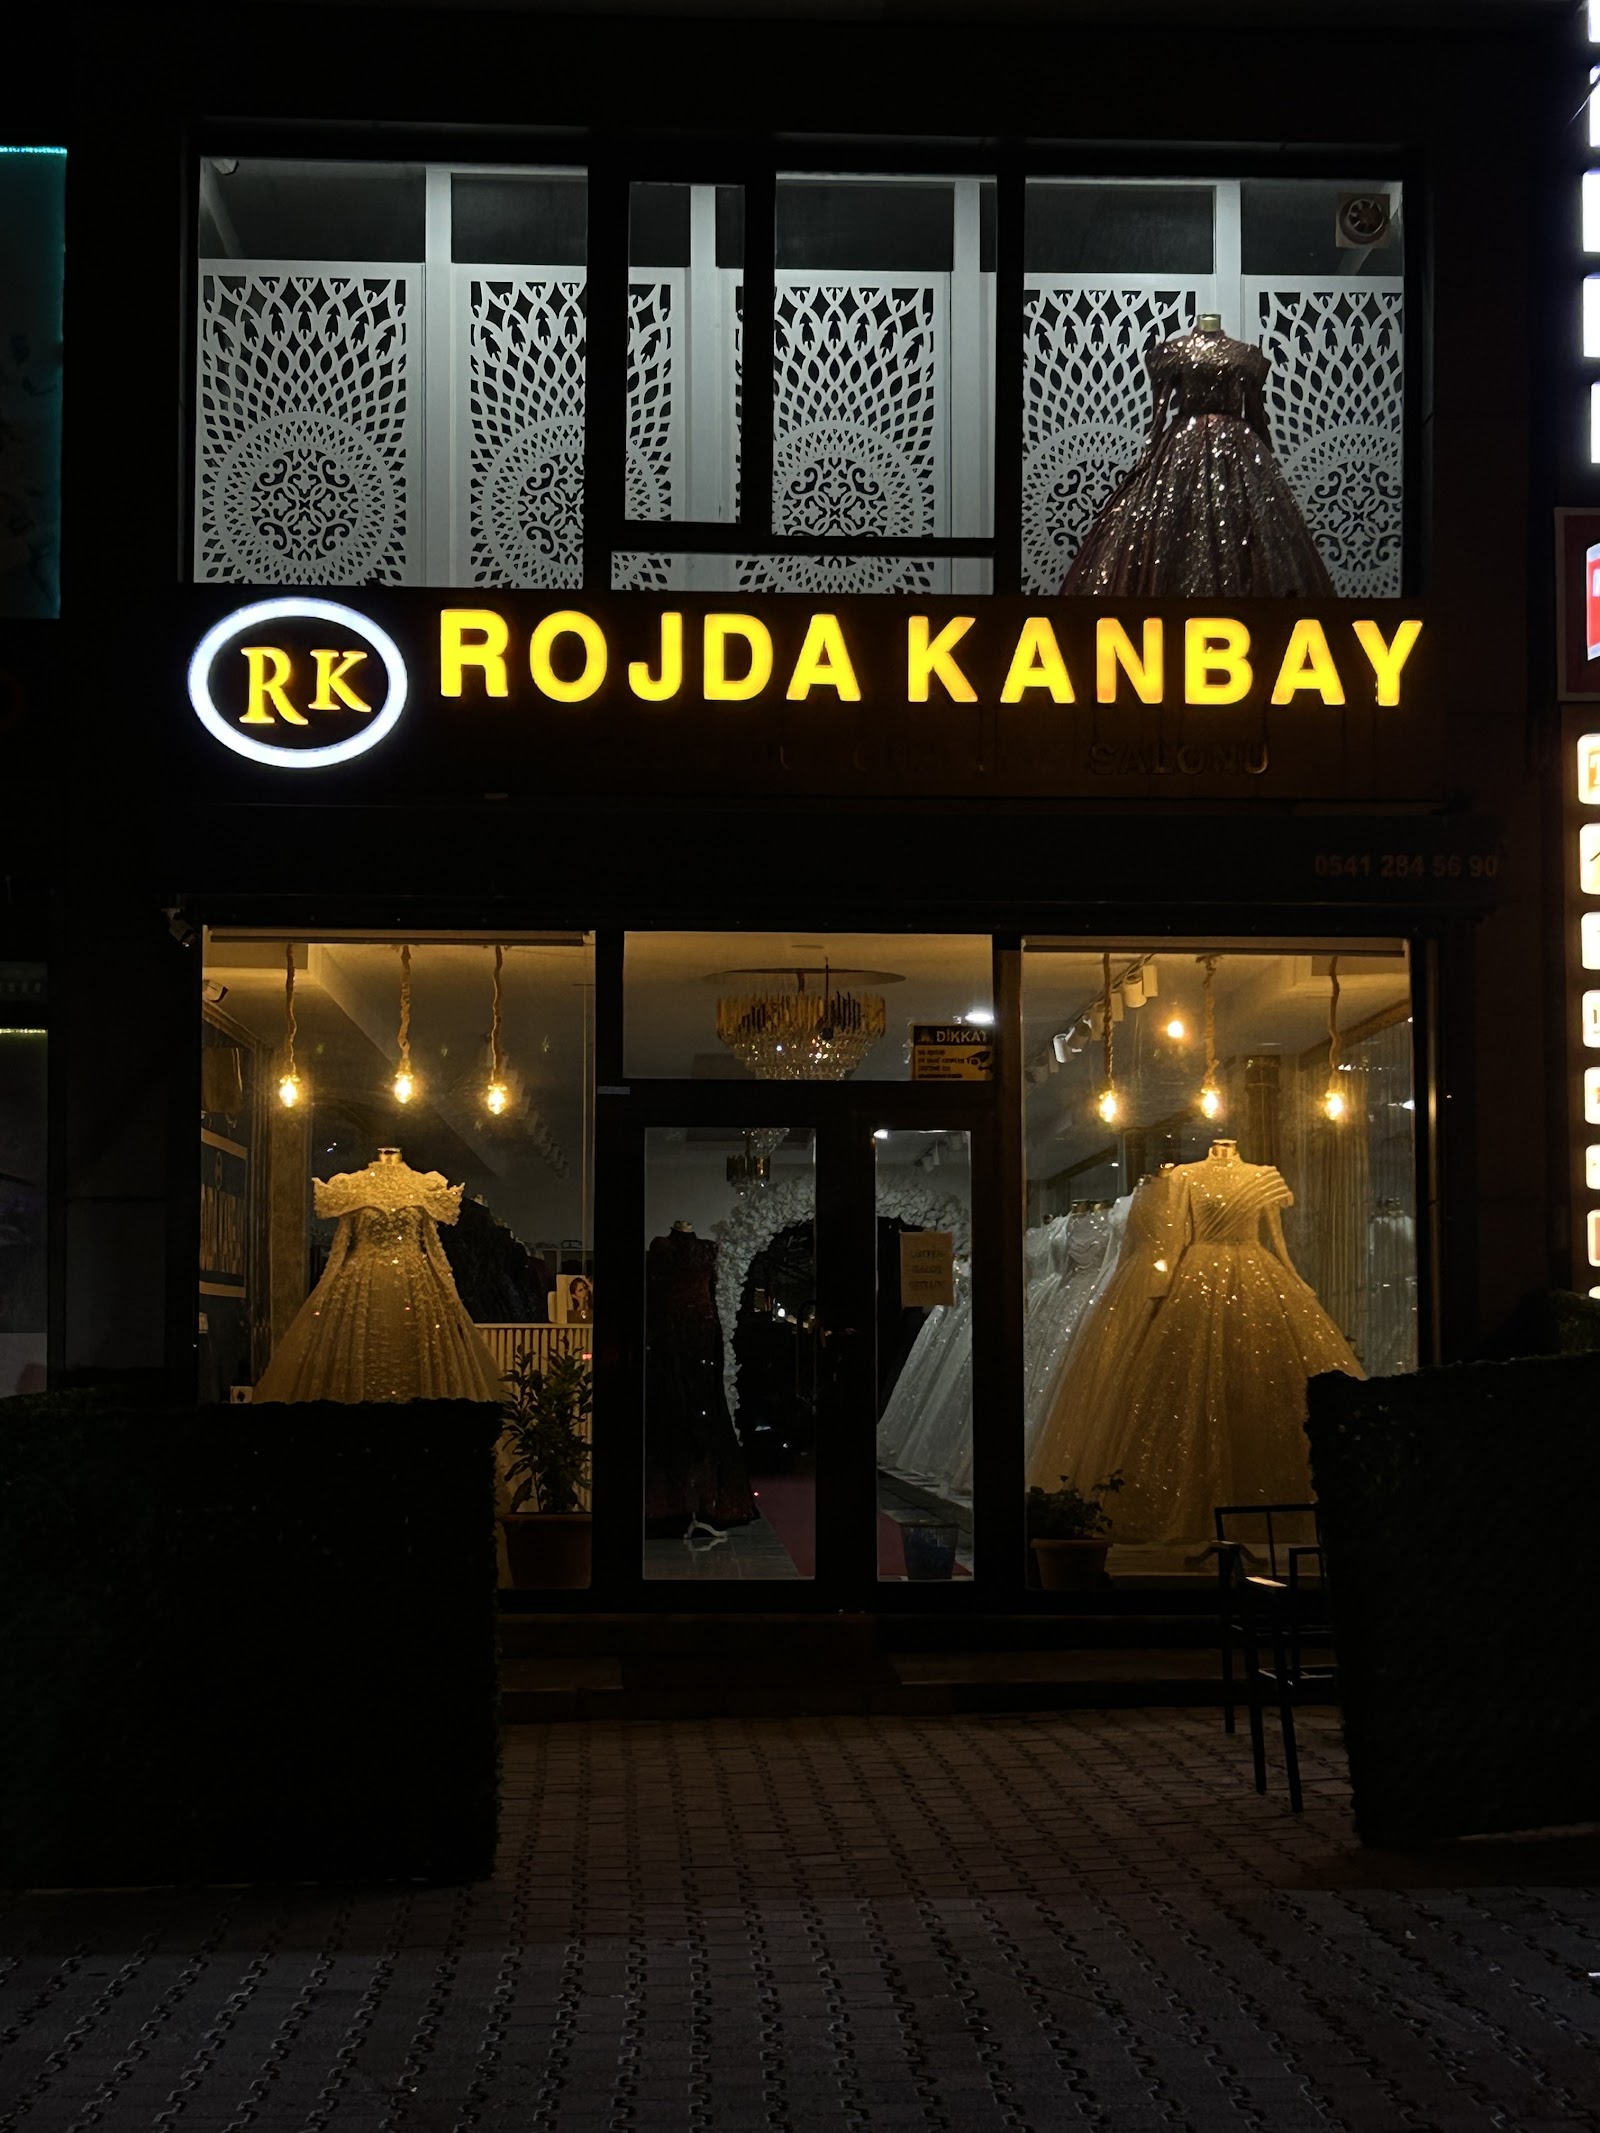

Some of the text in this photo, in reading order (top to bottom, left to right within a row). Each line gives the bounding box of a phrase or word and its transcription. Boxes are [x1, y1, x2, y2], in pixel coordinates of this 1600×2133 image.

[439, 608, 1423, 708] ROJDA KANBAY
[1087, 741, 1270, 776] SALONU
